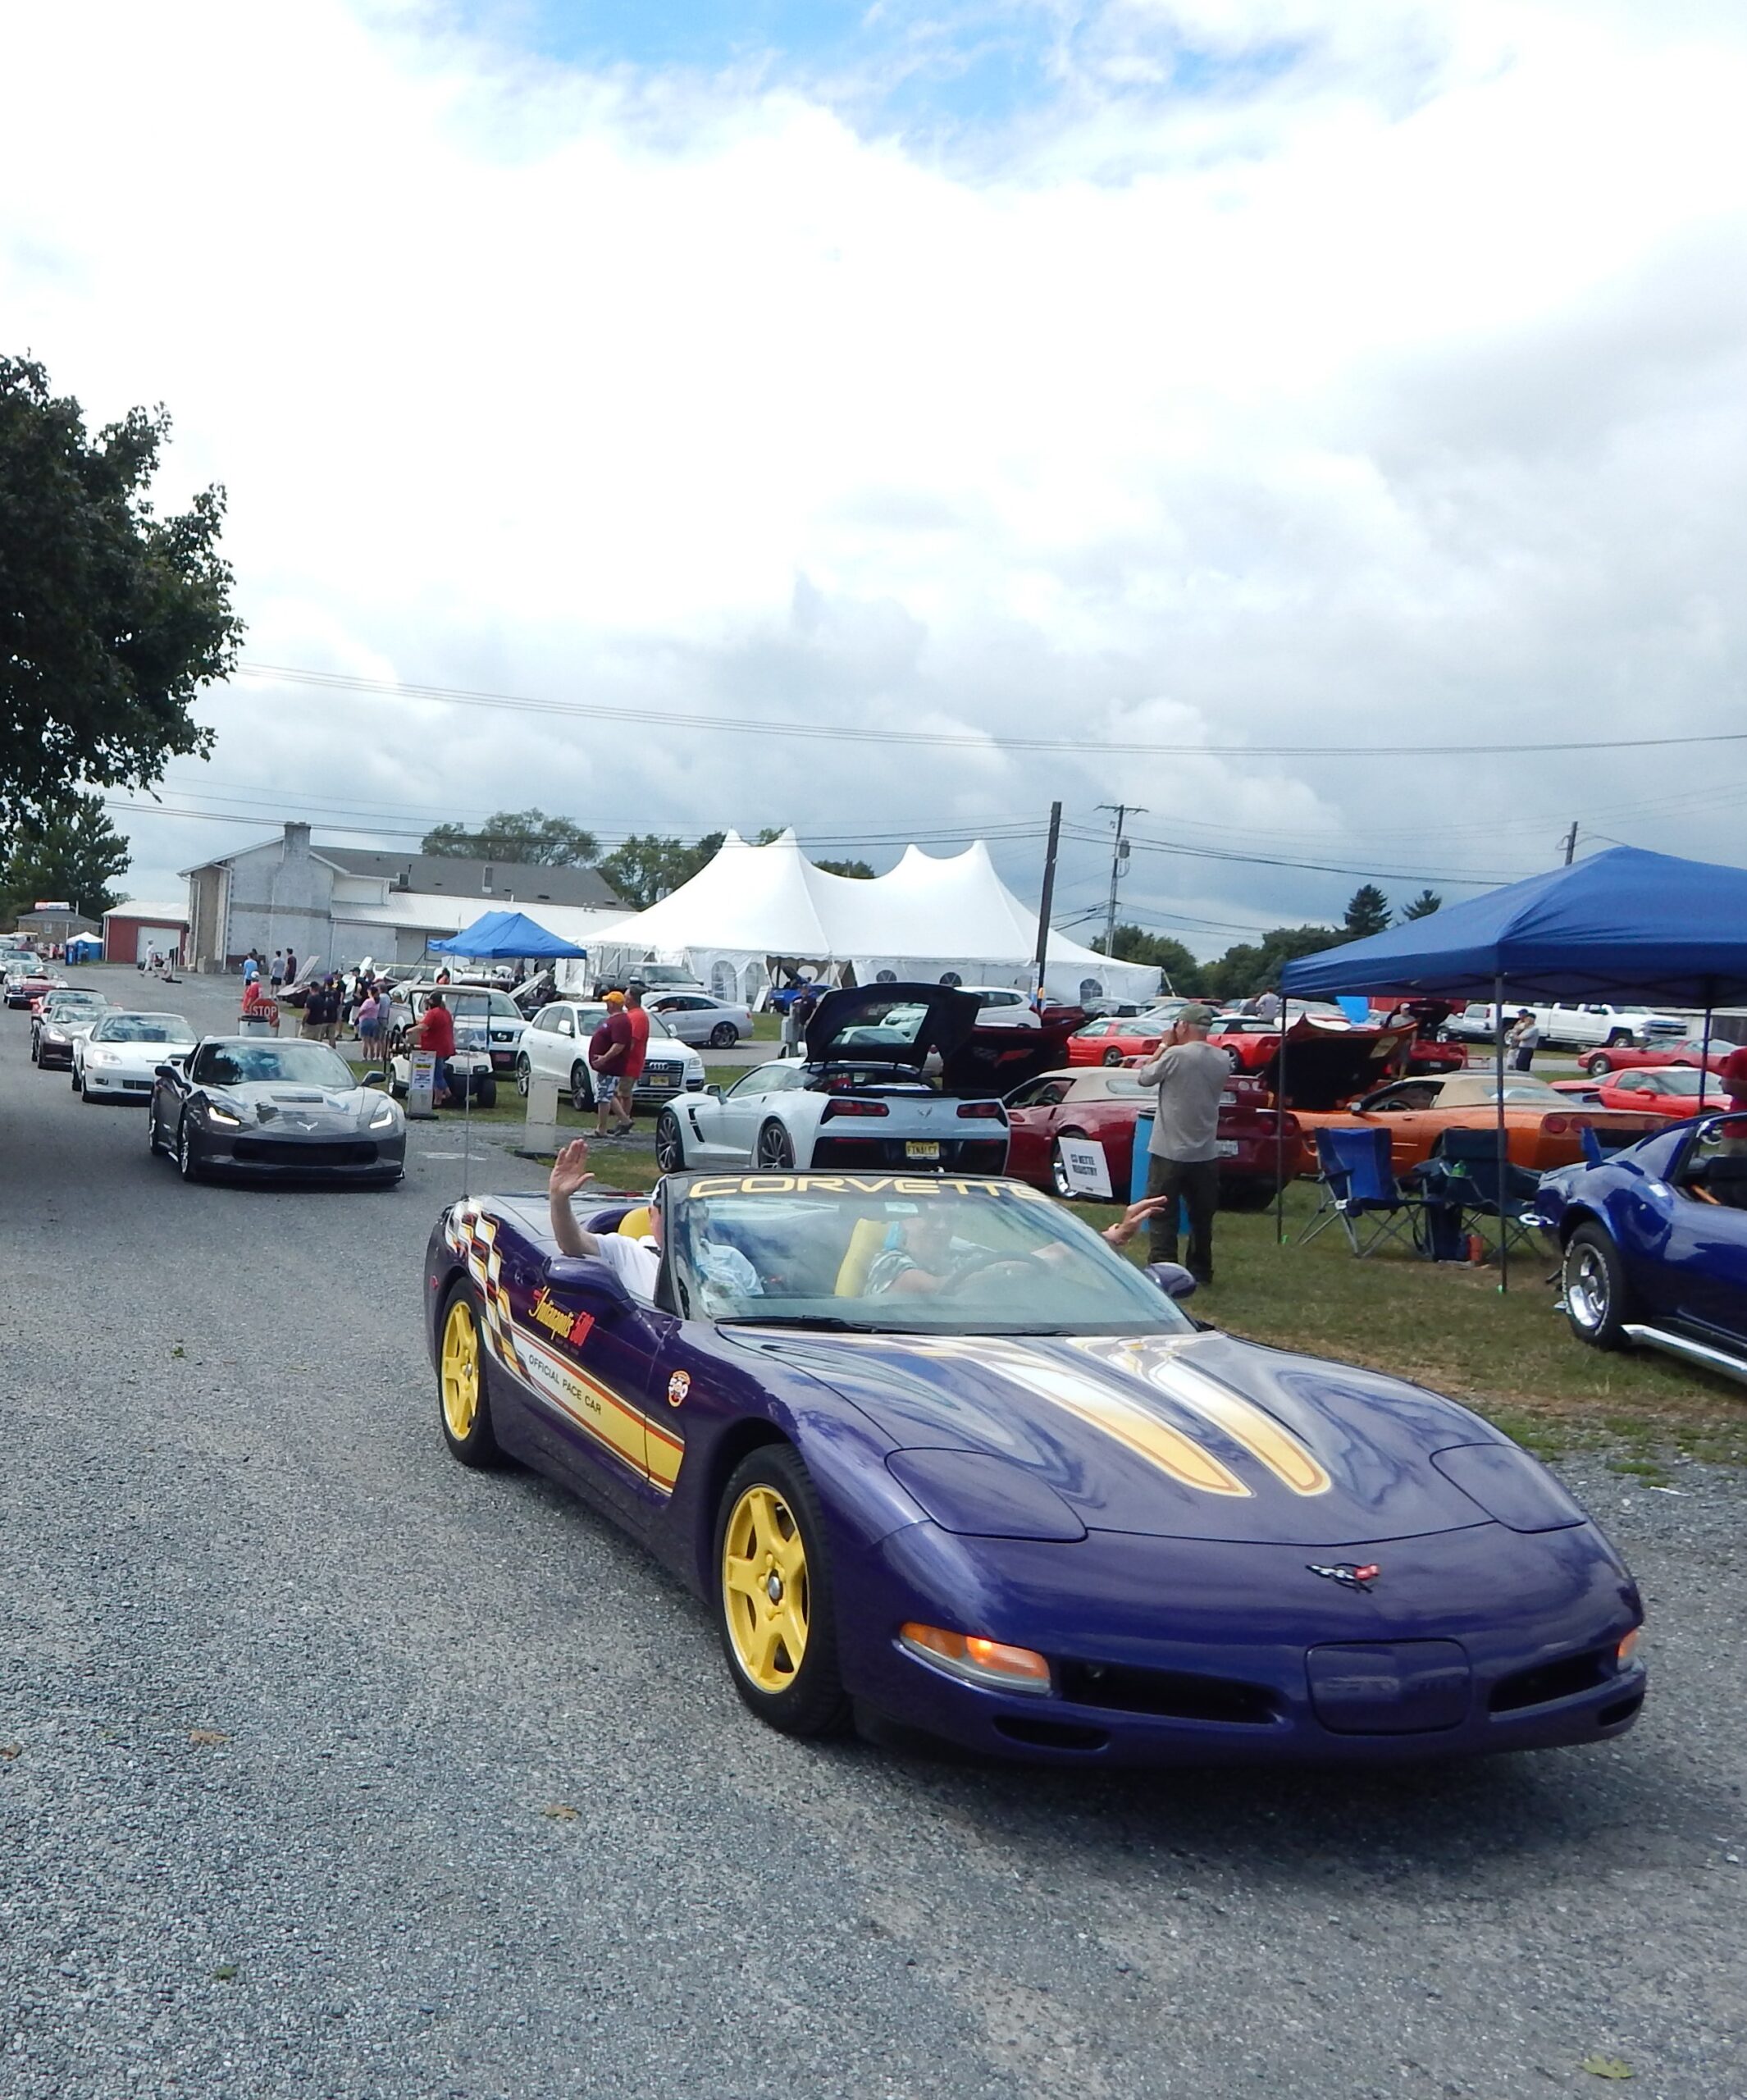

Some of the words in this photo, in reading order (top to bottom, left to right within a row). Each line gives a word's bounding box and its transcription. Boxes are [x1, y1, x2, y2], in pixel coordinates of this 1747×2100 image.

[252, 1006, 277, 1017] STOP
[689, 1177, 1048, 1201] CORVETTE
[569, 1311, 595, 1346] 500
[528, 1354, 559, 1384] OFFICIAL
[562, 1379, 582, 1400] PACE
[584, 1395, 602, 1415] CAR
